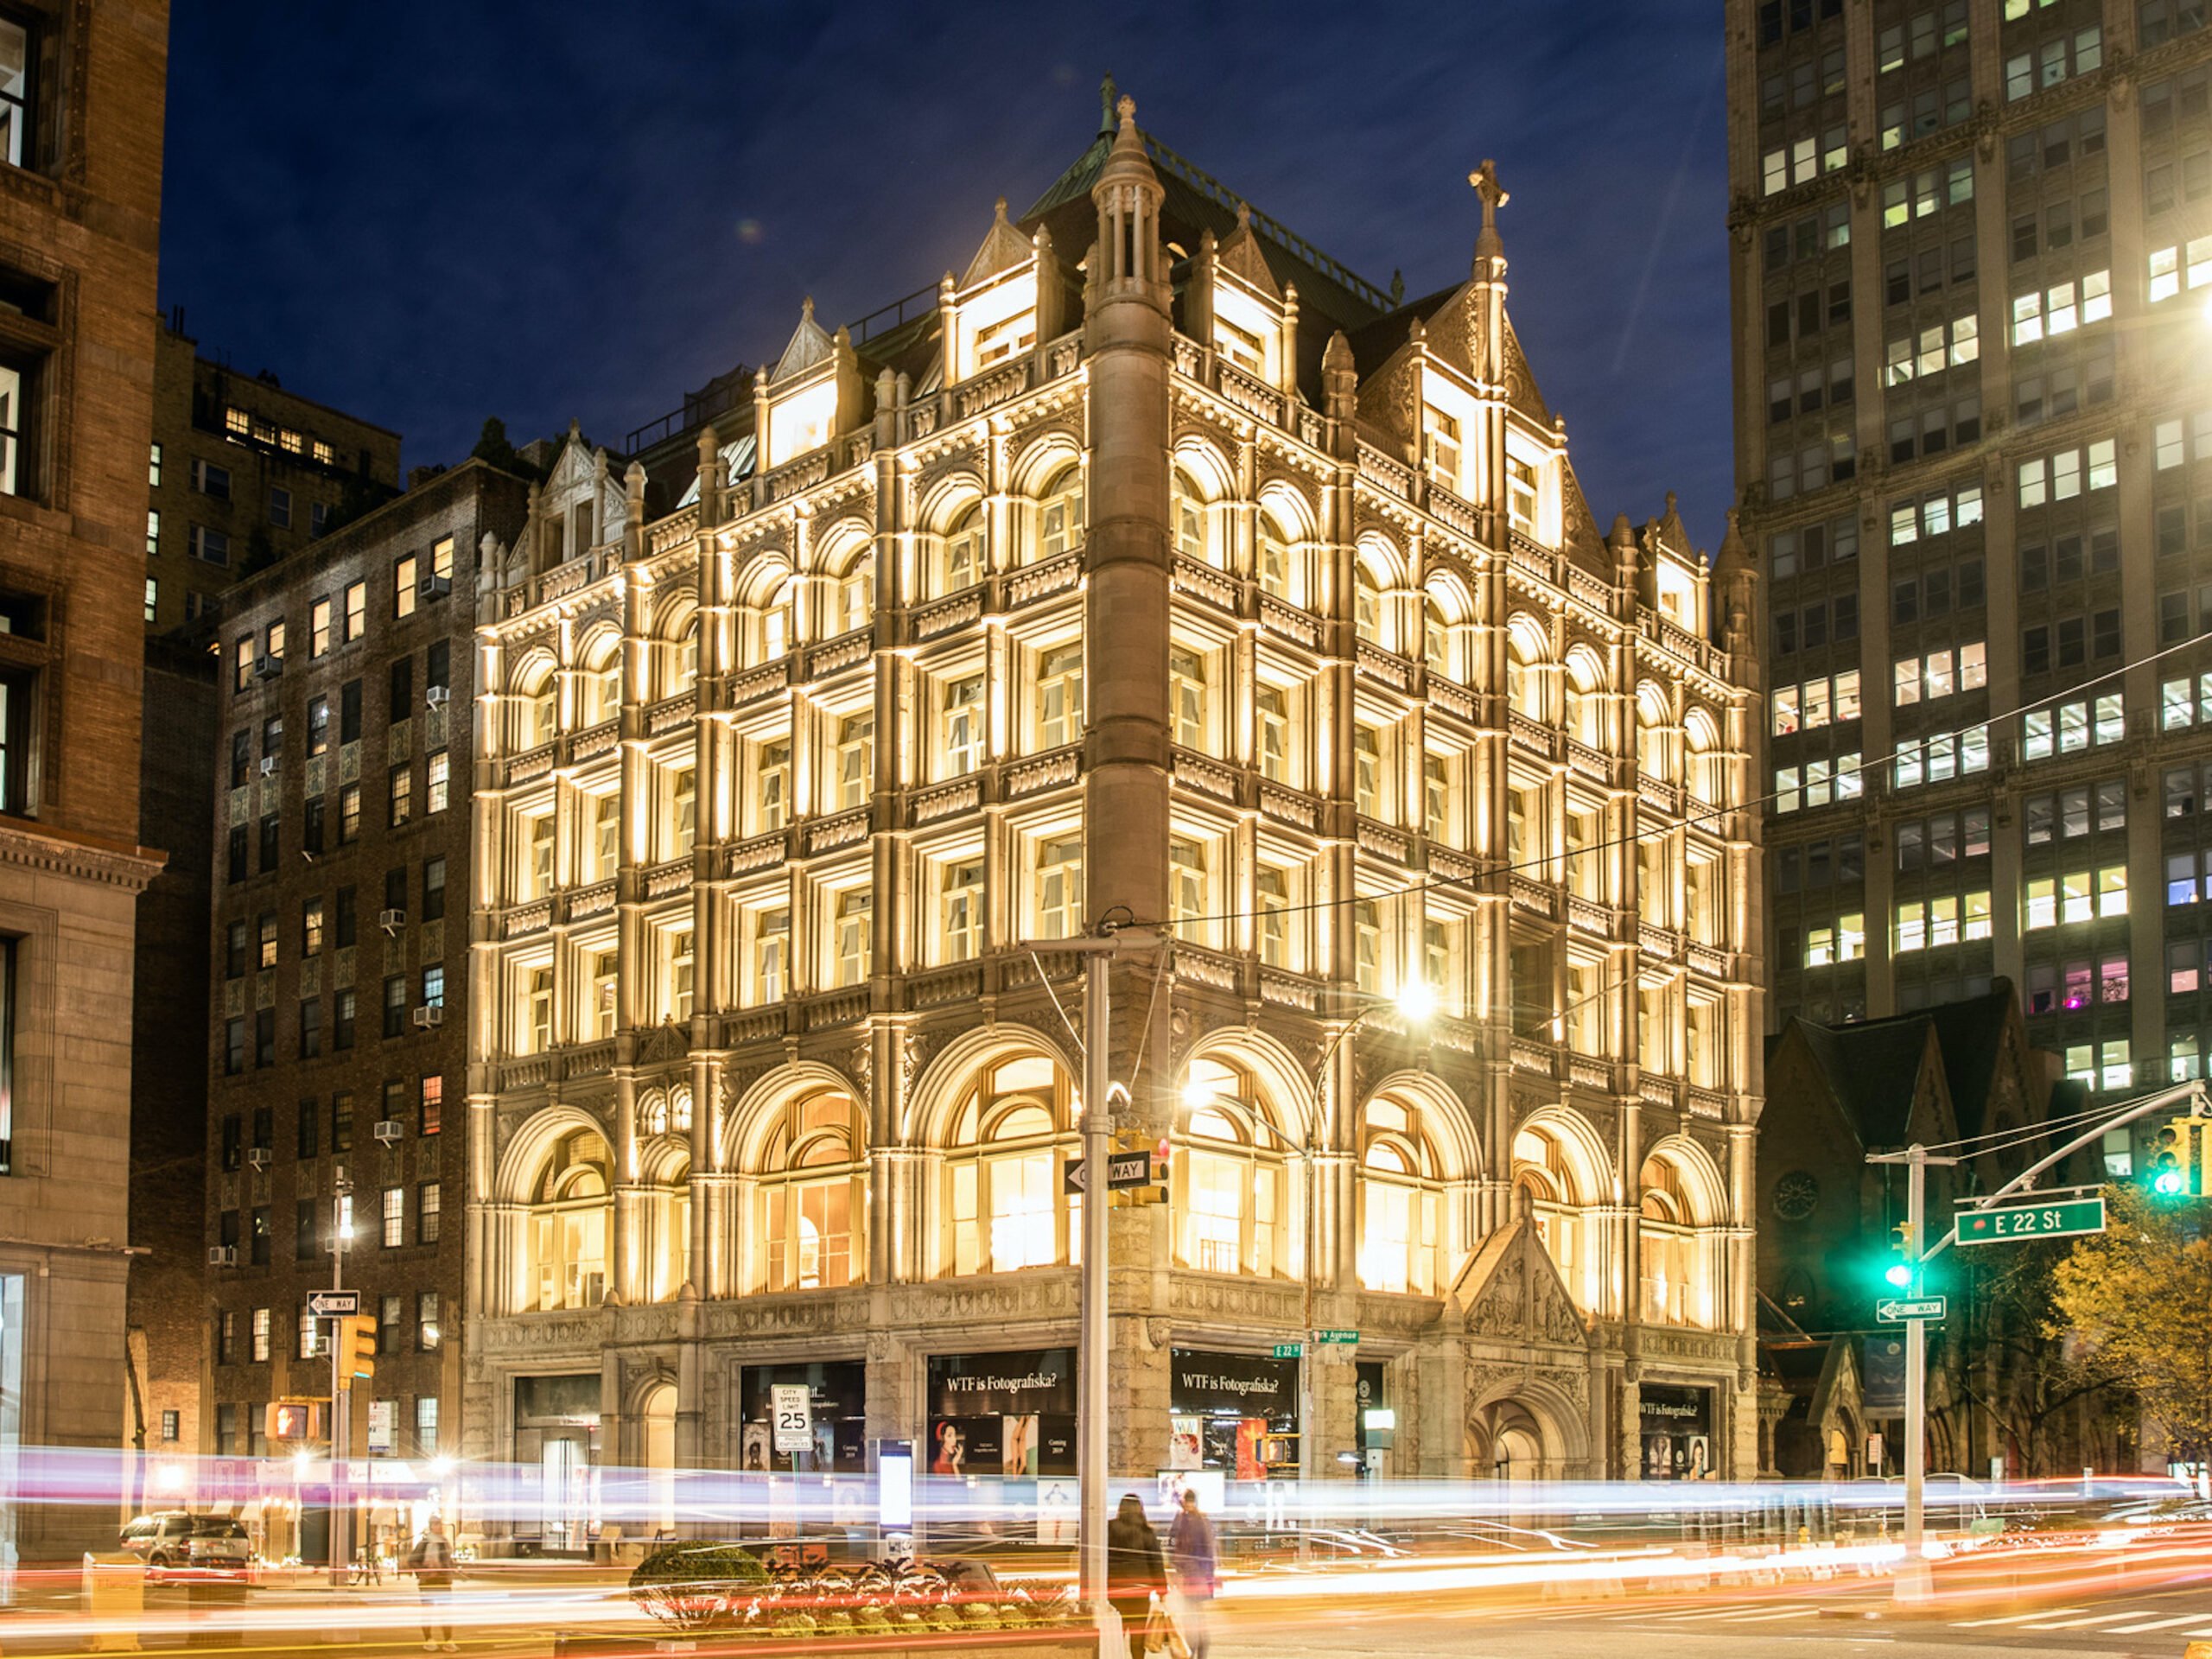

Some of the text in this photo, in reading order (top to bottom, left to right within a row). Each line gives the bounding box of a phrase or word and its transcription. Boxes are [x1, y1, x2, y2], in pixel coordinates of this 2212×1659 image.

[1113, 1163, 1138, 1178] WAY
[1995, 1211, 2062, 1234] E 22 St
[315, 1300, 352, 1309] ONE WAY
[1886, 1303, 1940, 1314] ONE WAY
[1276, 1346, 1281, 1357] E
[1283, 1346, 1292, 1356] 22
[947, 1372, 1057, 1394] WTF is Fotografiska?
[1182, 1373, 1279, 1396] WTF is Fotografiska?
[779, 1413, 805, 1429] 25
